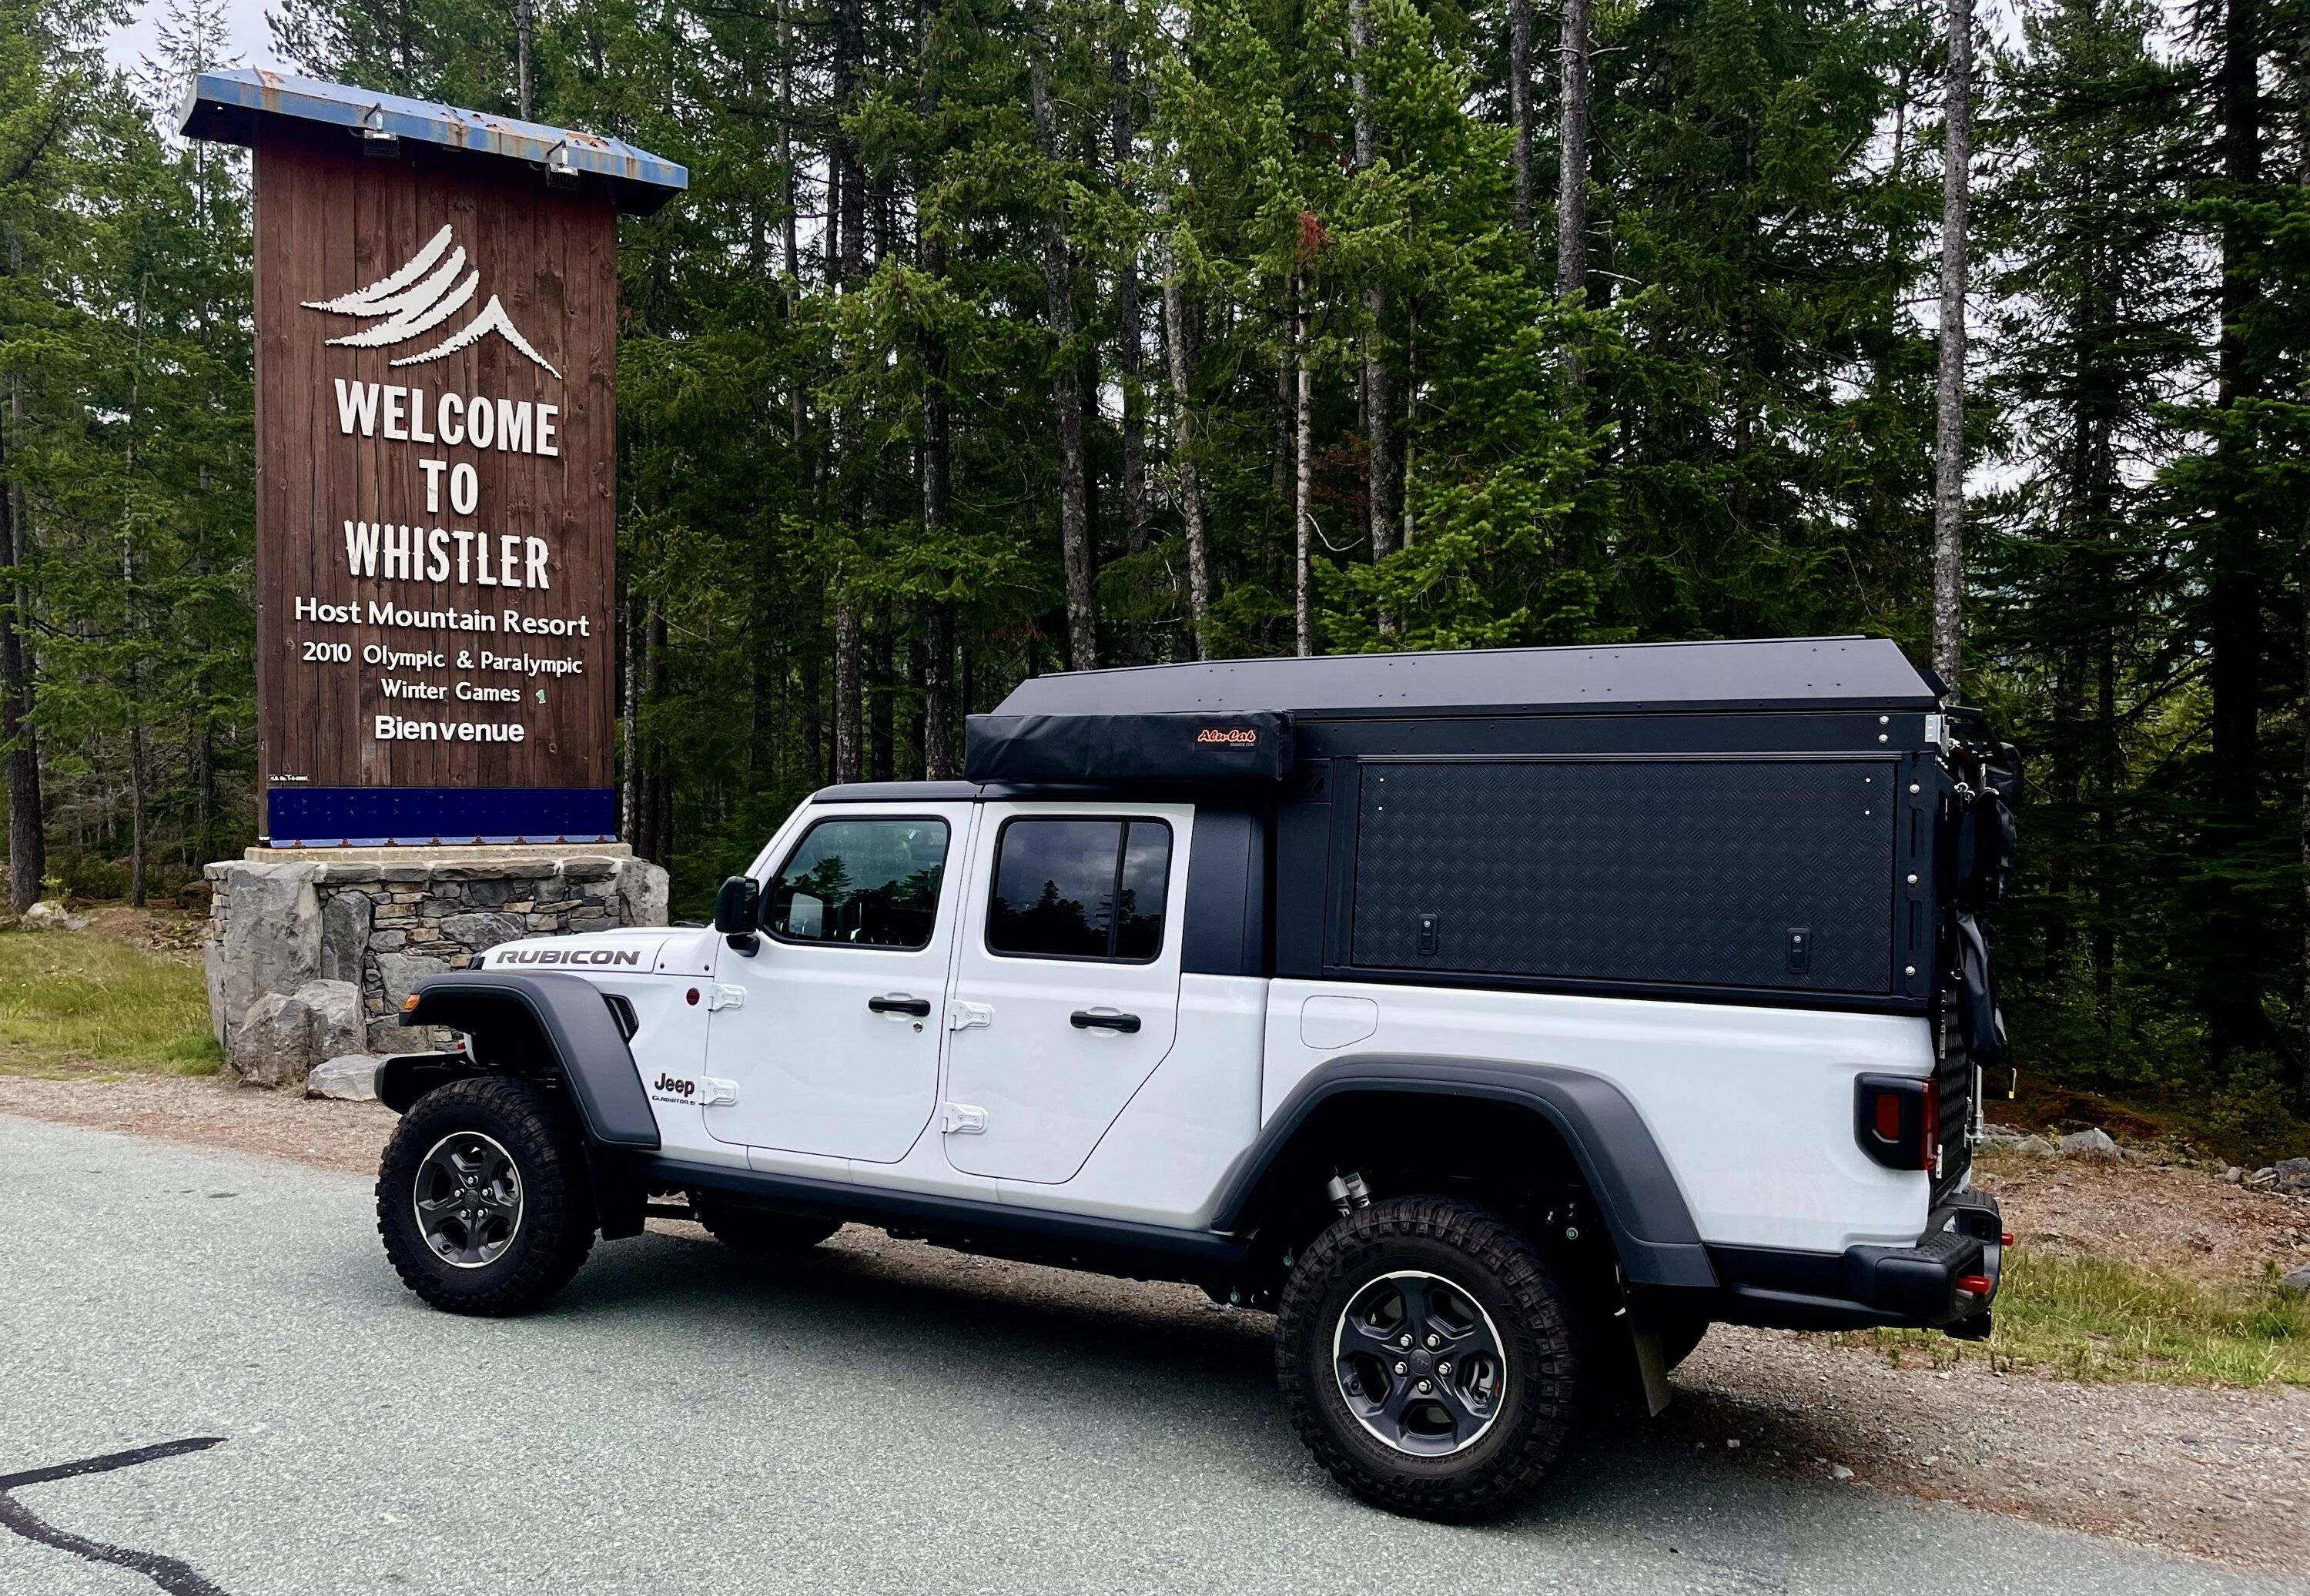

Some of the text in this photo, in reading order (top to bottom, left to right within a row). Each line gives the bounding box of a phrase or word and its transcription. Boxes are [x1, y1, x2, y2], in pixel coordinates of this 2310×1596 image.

[334, 378, 559, 456] WELCOME
[419, 458, 478, 514] TO
[343, 519, 550, 589] WHISTLER
[295, 596, 590, 637] Host Mountain Resort
[303, 641, 583, 678] 2010 Olympic & Paralympic
[380, 678, 521, 702] Winter Games
[375, 715, 525, 742] Bienvenue
[1197, 729, 1256, 743] Alu-Cab
[496, 950, 641, 965] RUBICON
[654, 1072, 695, 1097] Jeep
